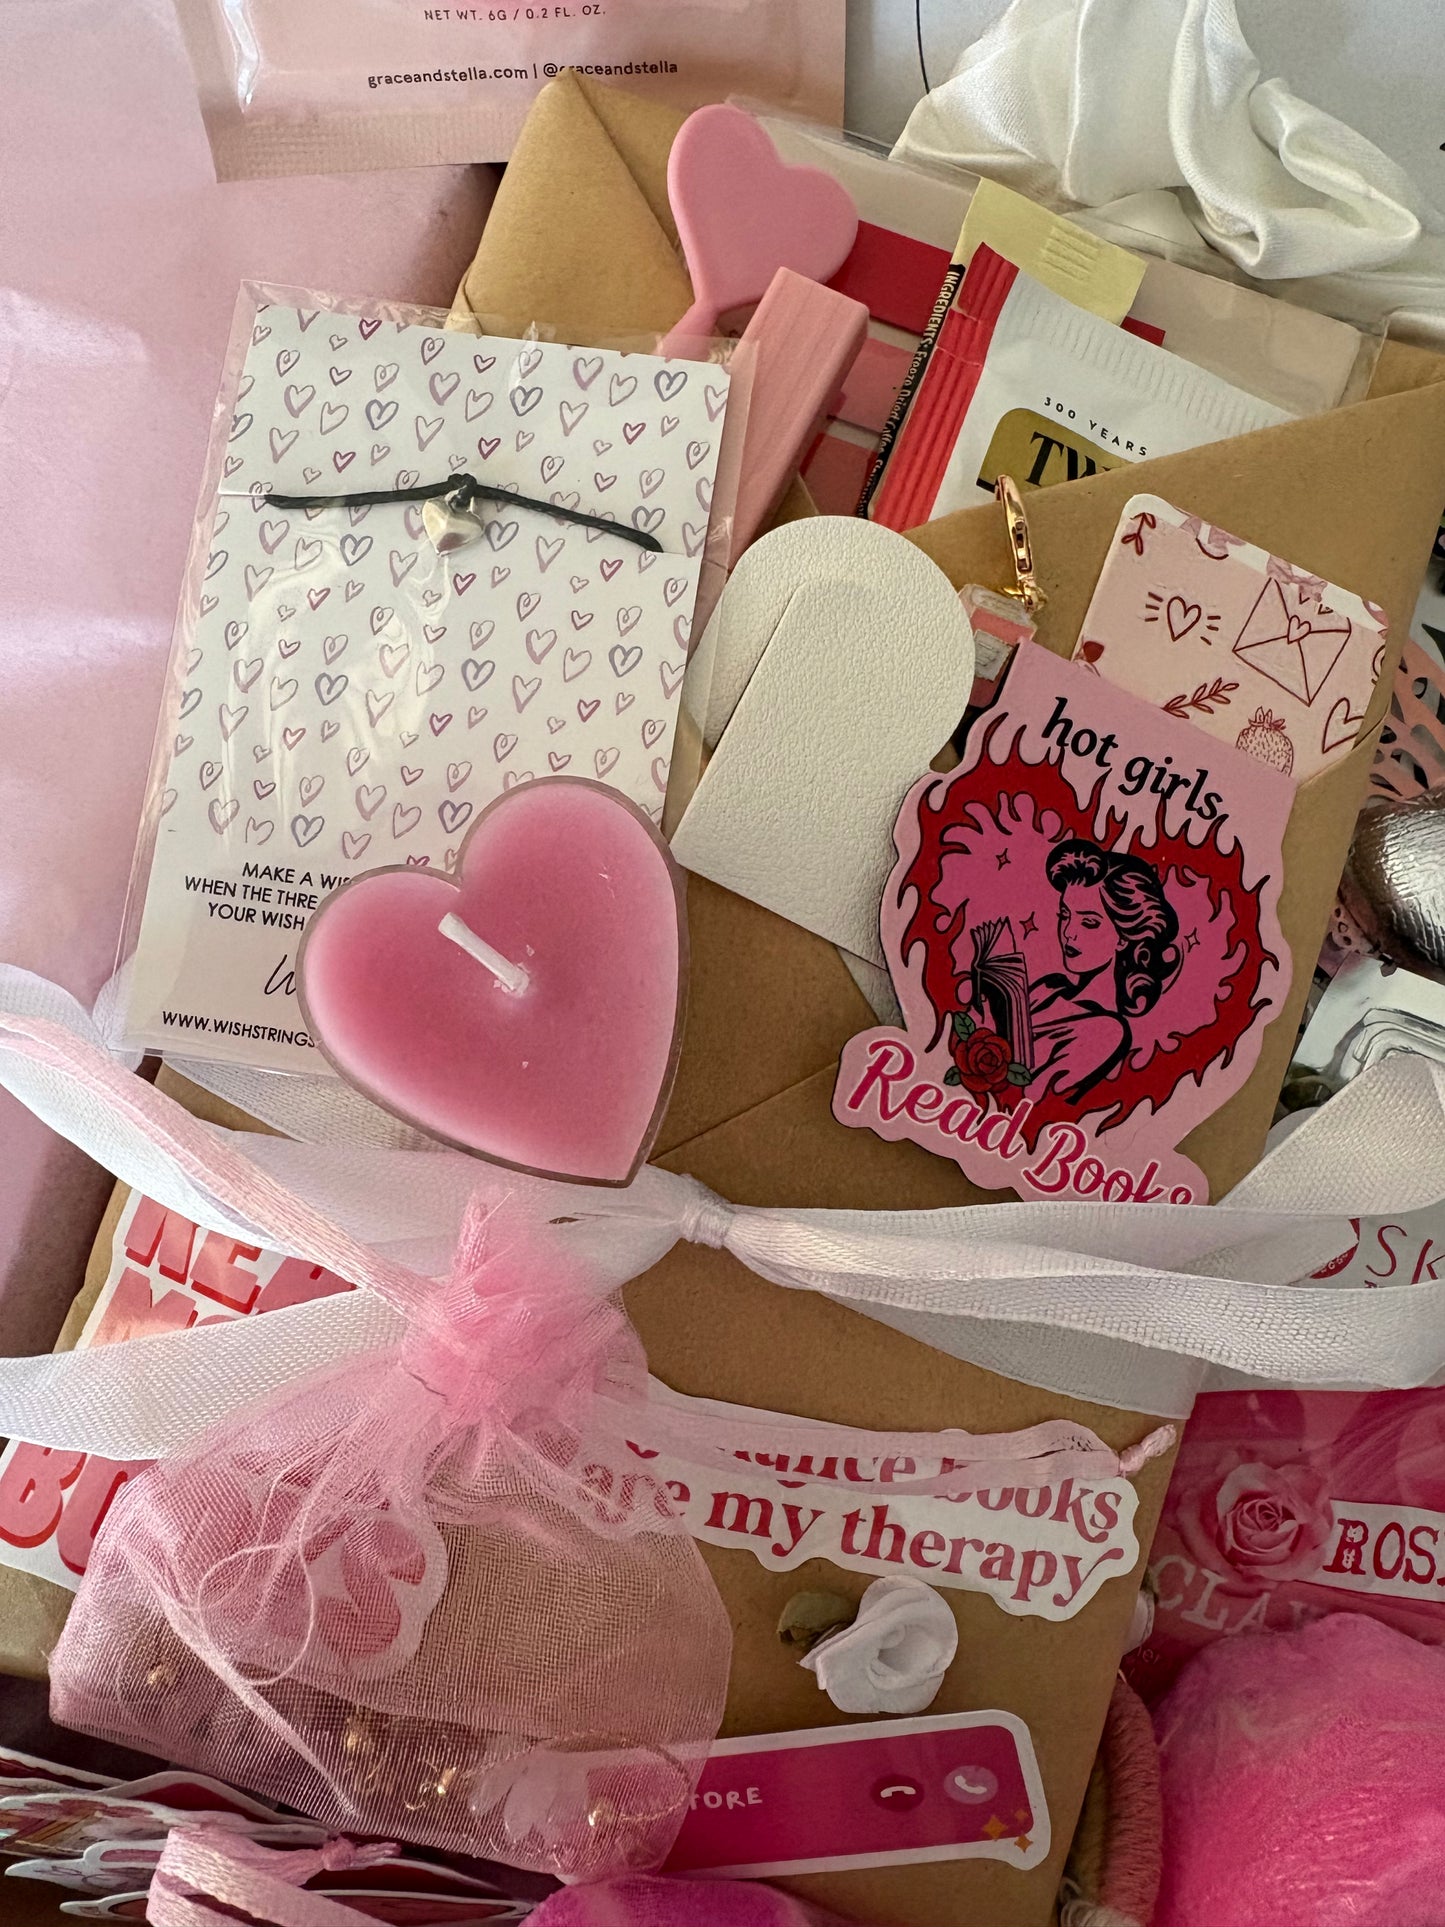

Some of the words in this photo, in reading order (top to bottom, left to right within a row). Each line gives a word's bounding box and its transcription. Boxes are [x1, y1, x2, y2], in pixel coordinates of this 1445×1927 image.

[424, 9, 451, 21] NET
[456, 9, 483, 21] WT.
[488, 9, 507, 21] 6G
[513, 8, 520, 21] /
[525, 7, 549, 20] 0.2
[554, 6, 577, 19] FL.
[582, 4, 607, 16] OZ.
[367, 66, 529, 89] graceandstella.com
[1043, 396, 1076, 420] 300
[1088, 419, 1148, 457] YEARS
[1041, 696, 1119, 768] hot
[1117, 756, 1223, 820] girls
[185, 875, 237, 898] WHEN
[242, 884, 273, 903] THE
[277, 889, 319, 910] THRE
[242, 862, 296, 884] MAKE
[299, 871, 314, 887] A
[208, 901, 257, 923] YOUR
[262, 910, 306, 931] WISH
[848, 1039, 1033, 1160] Read
[703, 1491, 826, 1558] my
[841, 1504, 1124, 1608] therapy
[1322, 1517, 1445, 1587] ROS
